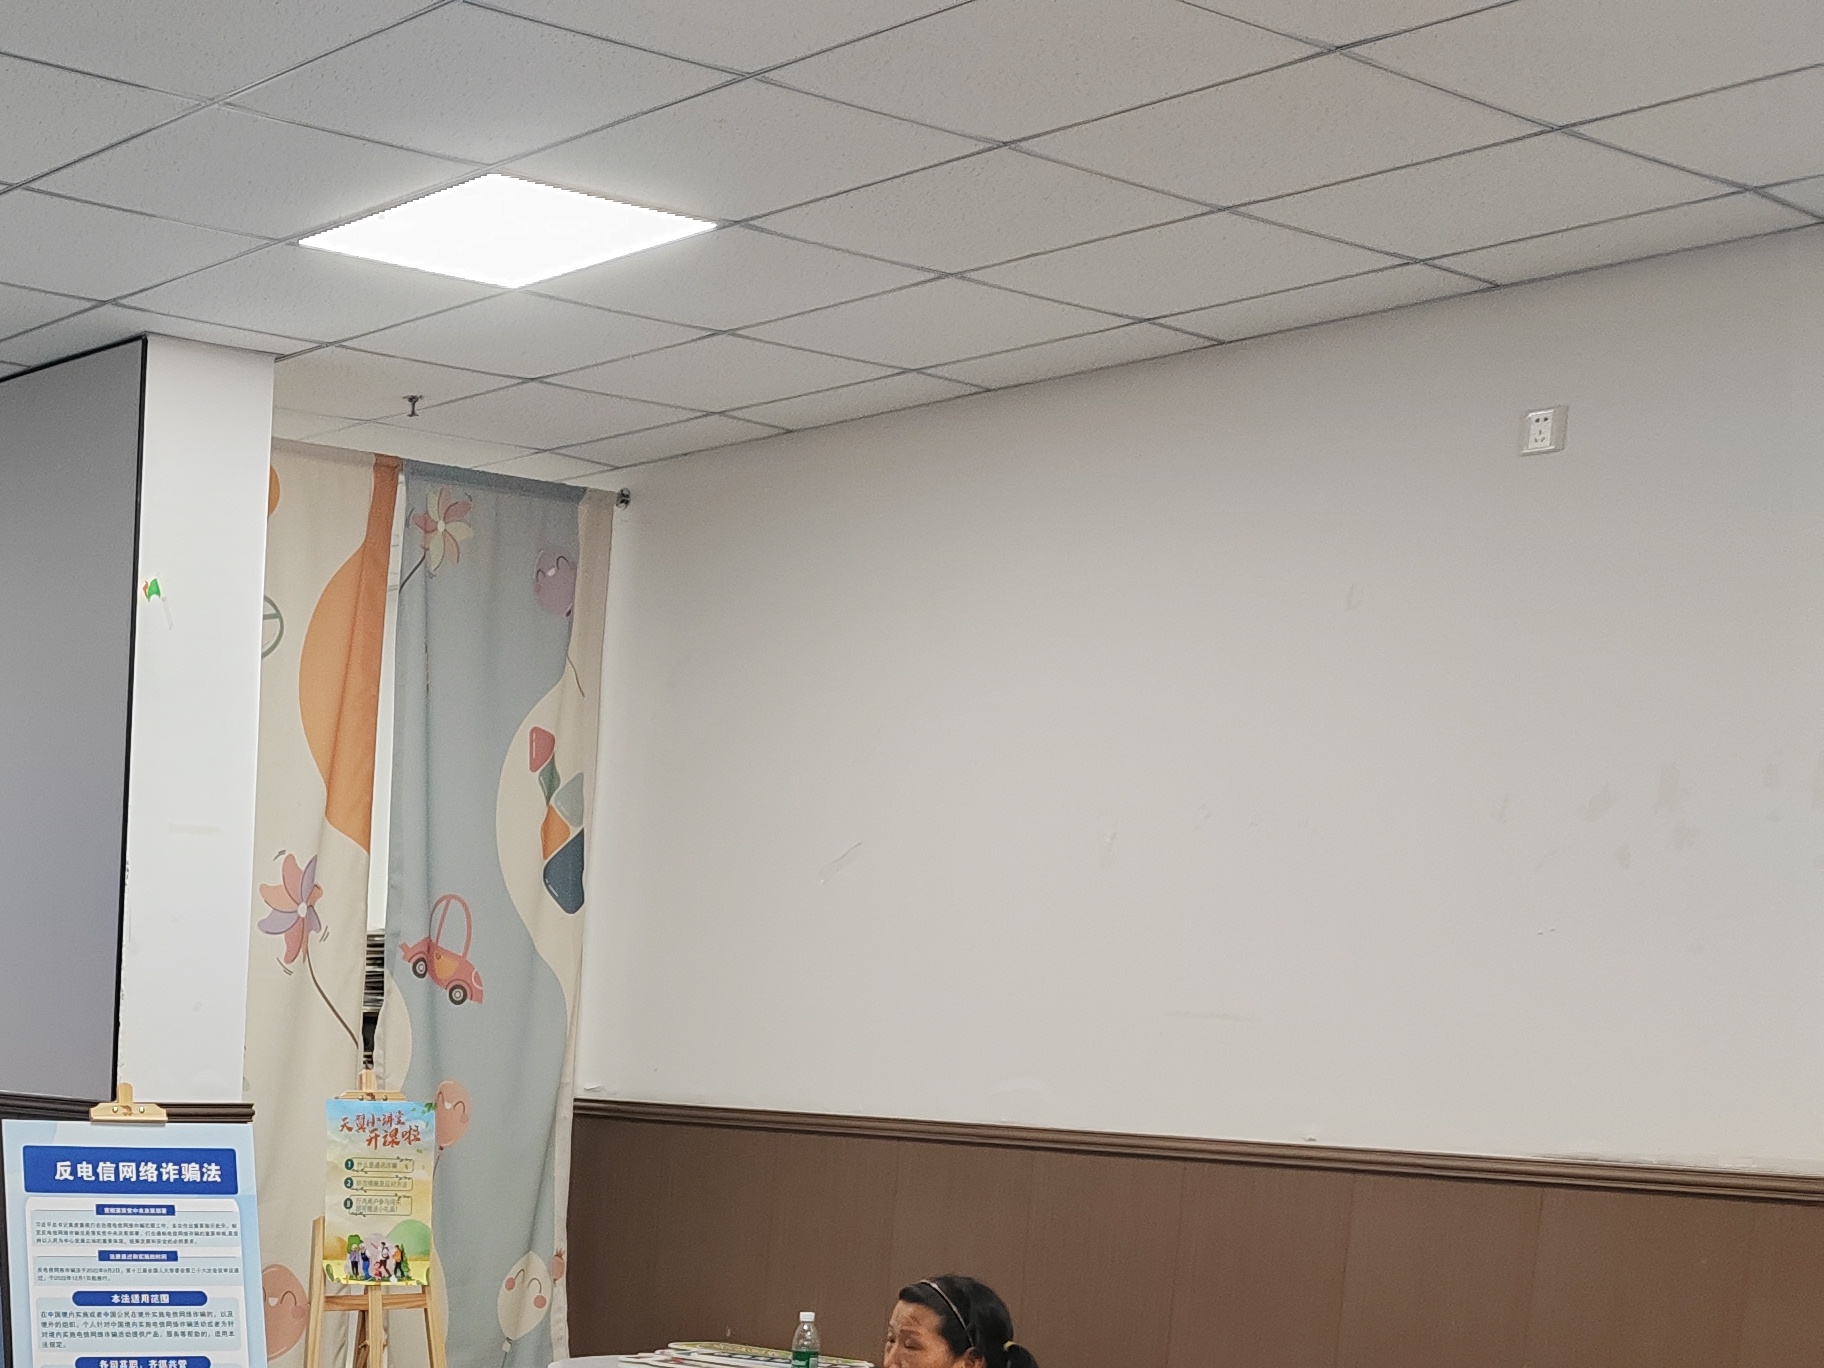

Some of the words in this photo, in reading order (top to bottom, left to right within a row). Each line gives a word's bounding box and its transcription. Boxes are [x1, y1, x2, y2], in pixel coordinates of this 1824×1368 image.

[366, 1125, 421, 1150] 开课啦
[54, 1161, 222, 1182] 反电信网络诈骗法
[111, 1293, 170, 1304] 本法适用范围
